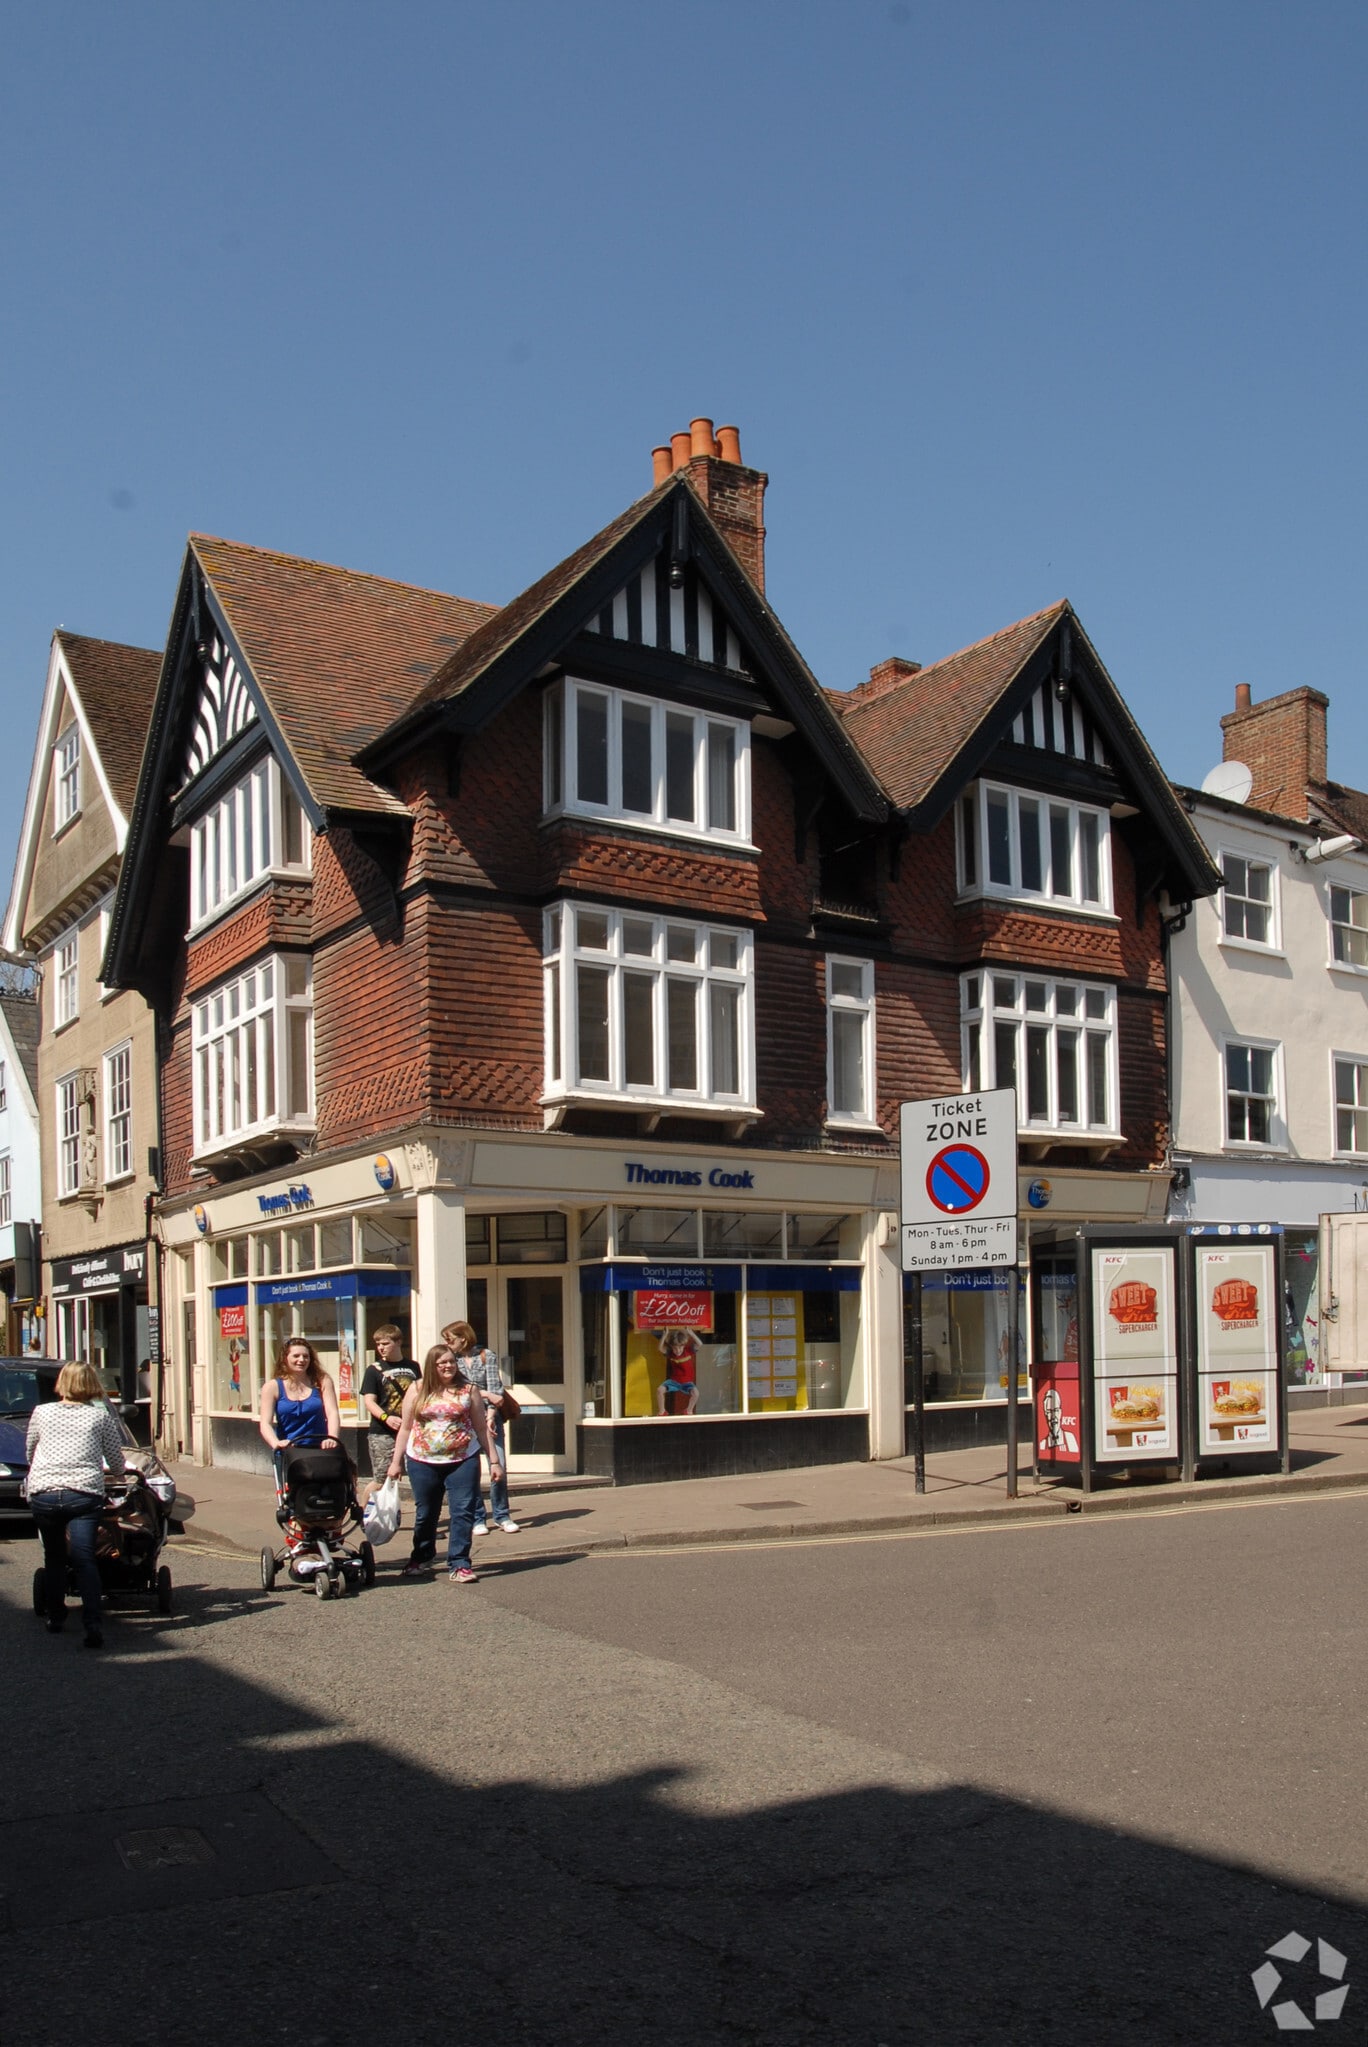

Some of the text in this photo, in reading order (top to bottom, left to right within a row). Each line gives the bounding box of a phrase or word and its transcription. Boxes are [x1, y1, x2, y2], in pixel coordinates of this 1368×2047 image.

[932, 1098, 982, 1117] Ticket
[926, 1118, 987, 1142] ZONE
[624, 1163, 755, 1188] Thomas Cook
[908, 1229, 929, 1238] Mon
[964, 1225, 988, 1234] Thur
[996, 1222, 1010, 1232] Fri
[930, 1241, 936, 1249] 8
[939, 1241, 954, 1249] am
[962, 1239, 968, 1247] 6
[971, 1239, 987, 1248] pm
[911, 1255, 948, 1265] Sunday
[981, 1252, 988, 1260] 4
[991, 1253, 1007, 1262] pm
[642, 1267, 665, 1276] Don't
[666, 1267, 682, 1278] just
[683, 1267, 706, 1276] book
[647, 1277, 681, 1286] Thomas
[682, 1277, 705, 1286] Cook
[943, 1273, 971, 1285] Don't
[973, 1273, 992, 1287] just
[1111, 1283, 1149, 1309] SWEET
[1212, 1281, 1250, 1306] SWEET
[640, 1298, 706, 1317] £200 off
[1118, 1323, 1158, 1334] SUPERCHARGER
[1221, 1320, 1259, 1331] SUPERCHARGER
[1061, 1416, 1077, 1426] KFC
